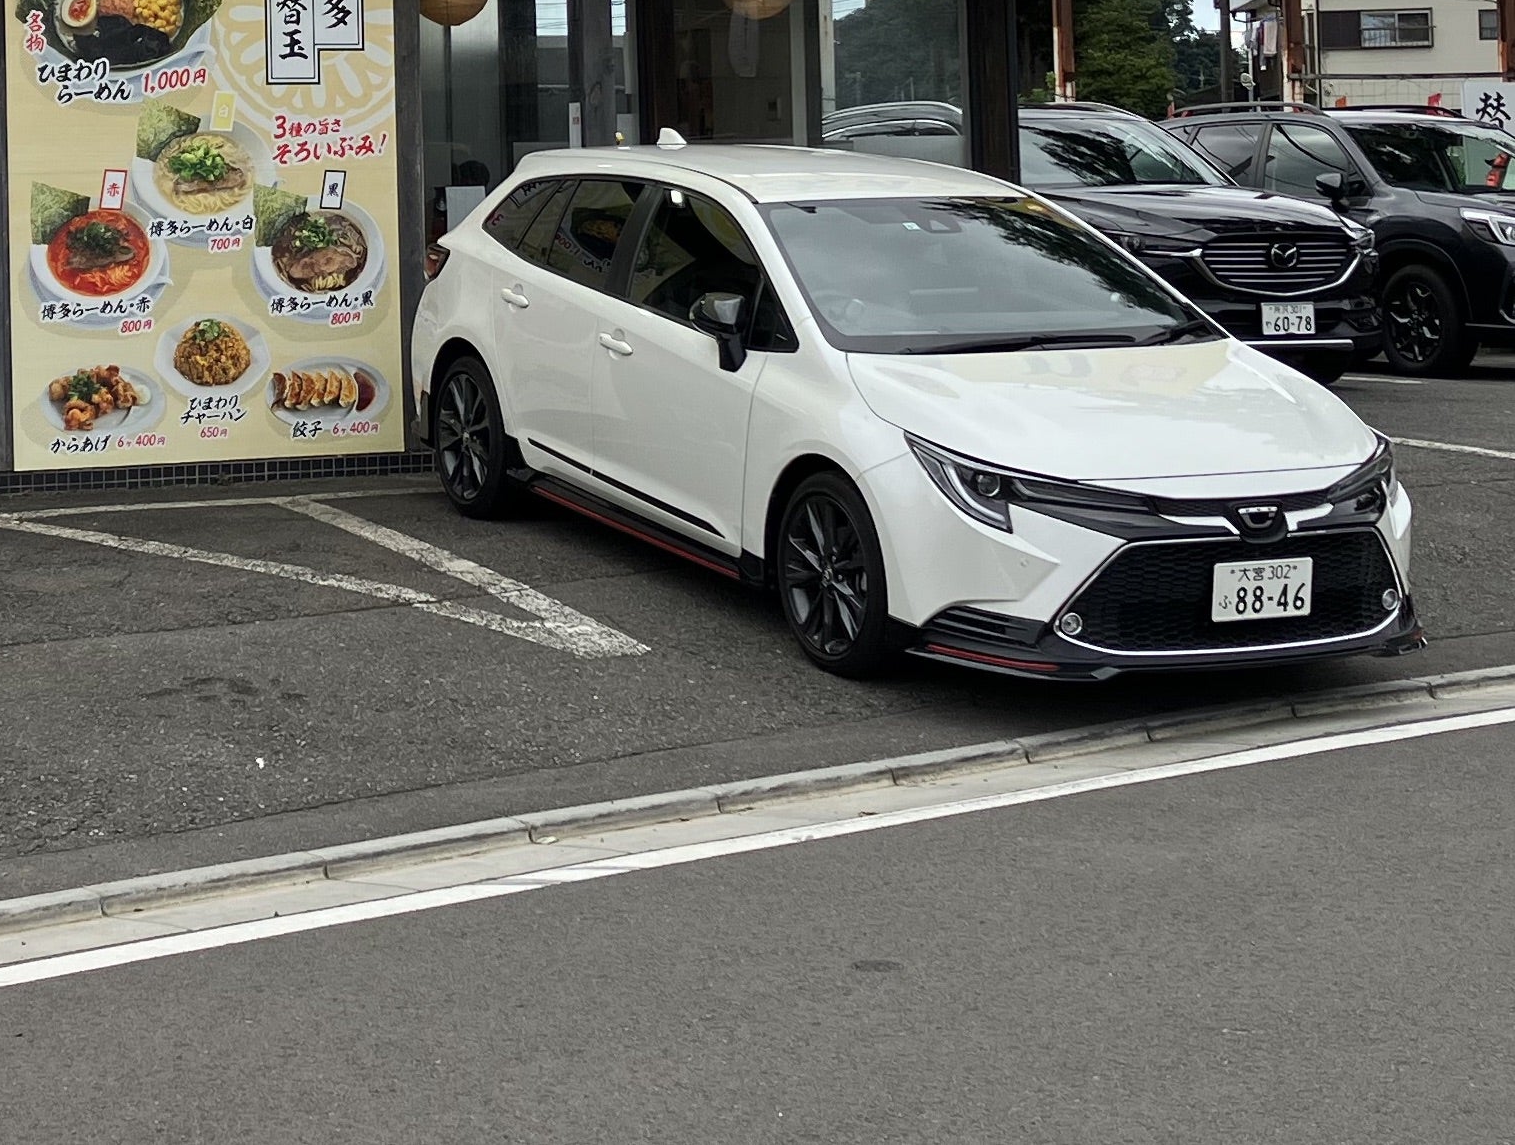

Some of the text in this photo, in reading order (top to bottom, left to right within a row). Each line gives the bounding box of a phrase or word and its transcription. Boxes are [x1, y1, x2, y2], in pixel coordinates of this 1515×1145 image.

[26, 12, 46, 52] 名物
[38, 60, 108, 82] ひまわり
[143, 69, 207, 93] 1,000円
[57, 81, 131, 104] らーめん
[273, 115, 342, 140] 3種の旨さ
[106, 182, 121, 198] 赤
[327, 182, 340, 198] 黒
[210, 238, 241, 251] 700円
[121, 319, 152, 333] 800円
[330, 311, 361, 325] 800円
[1274, 316, 1312, 332] 60-78
[189, 395, 238, 411] ひまわり
[180, 409, 247, 425] チャーハン
[200, 426, 227, 439] 650円
[292, 420, 323, 438] 餃子
[349, 421, 379, 434] 400円
[50, 434, 111, 453] からあげ
[136, 434, 166, 447] 400円
[1238, 564, 1292, 582] 大宮 302
[1219, 583, 1306, 614] ふ 88-46
